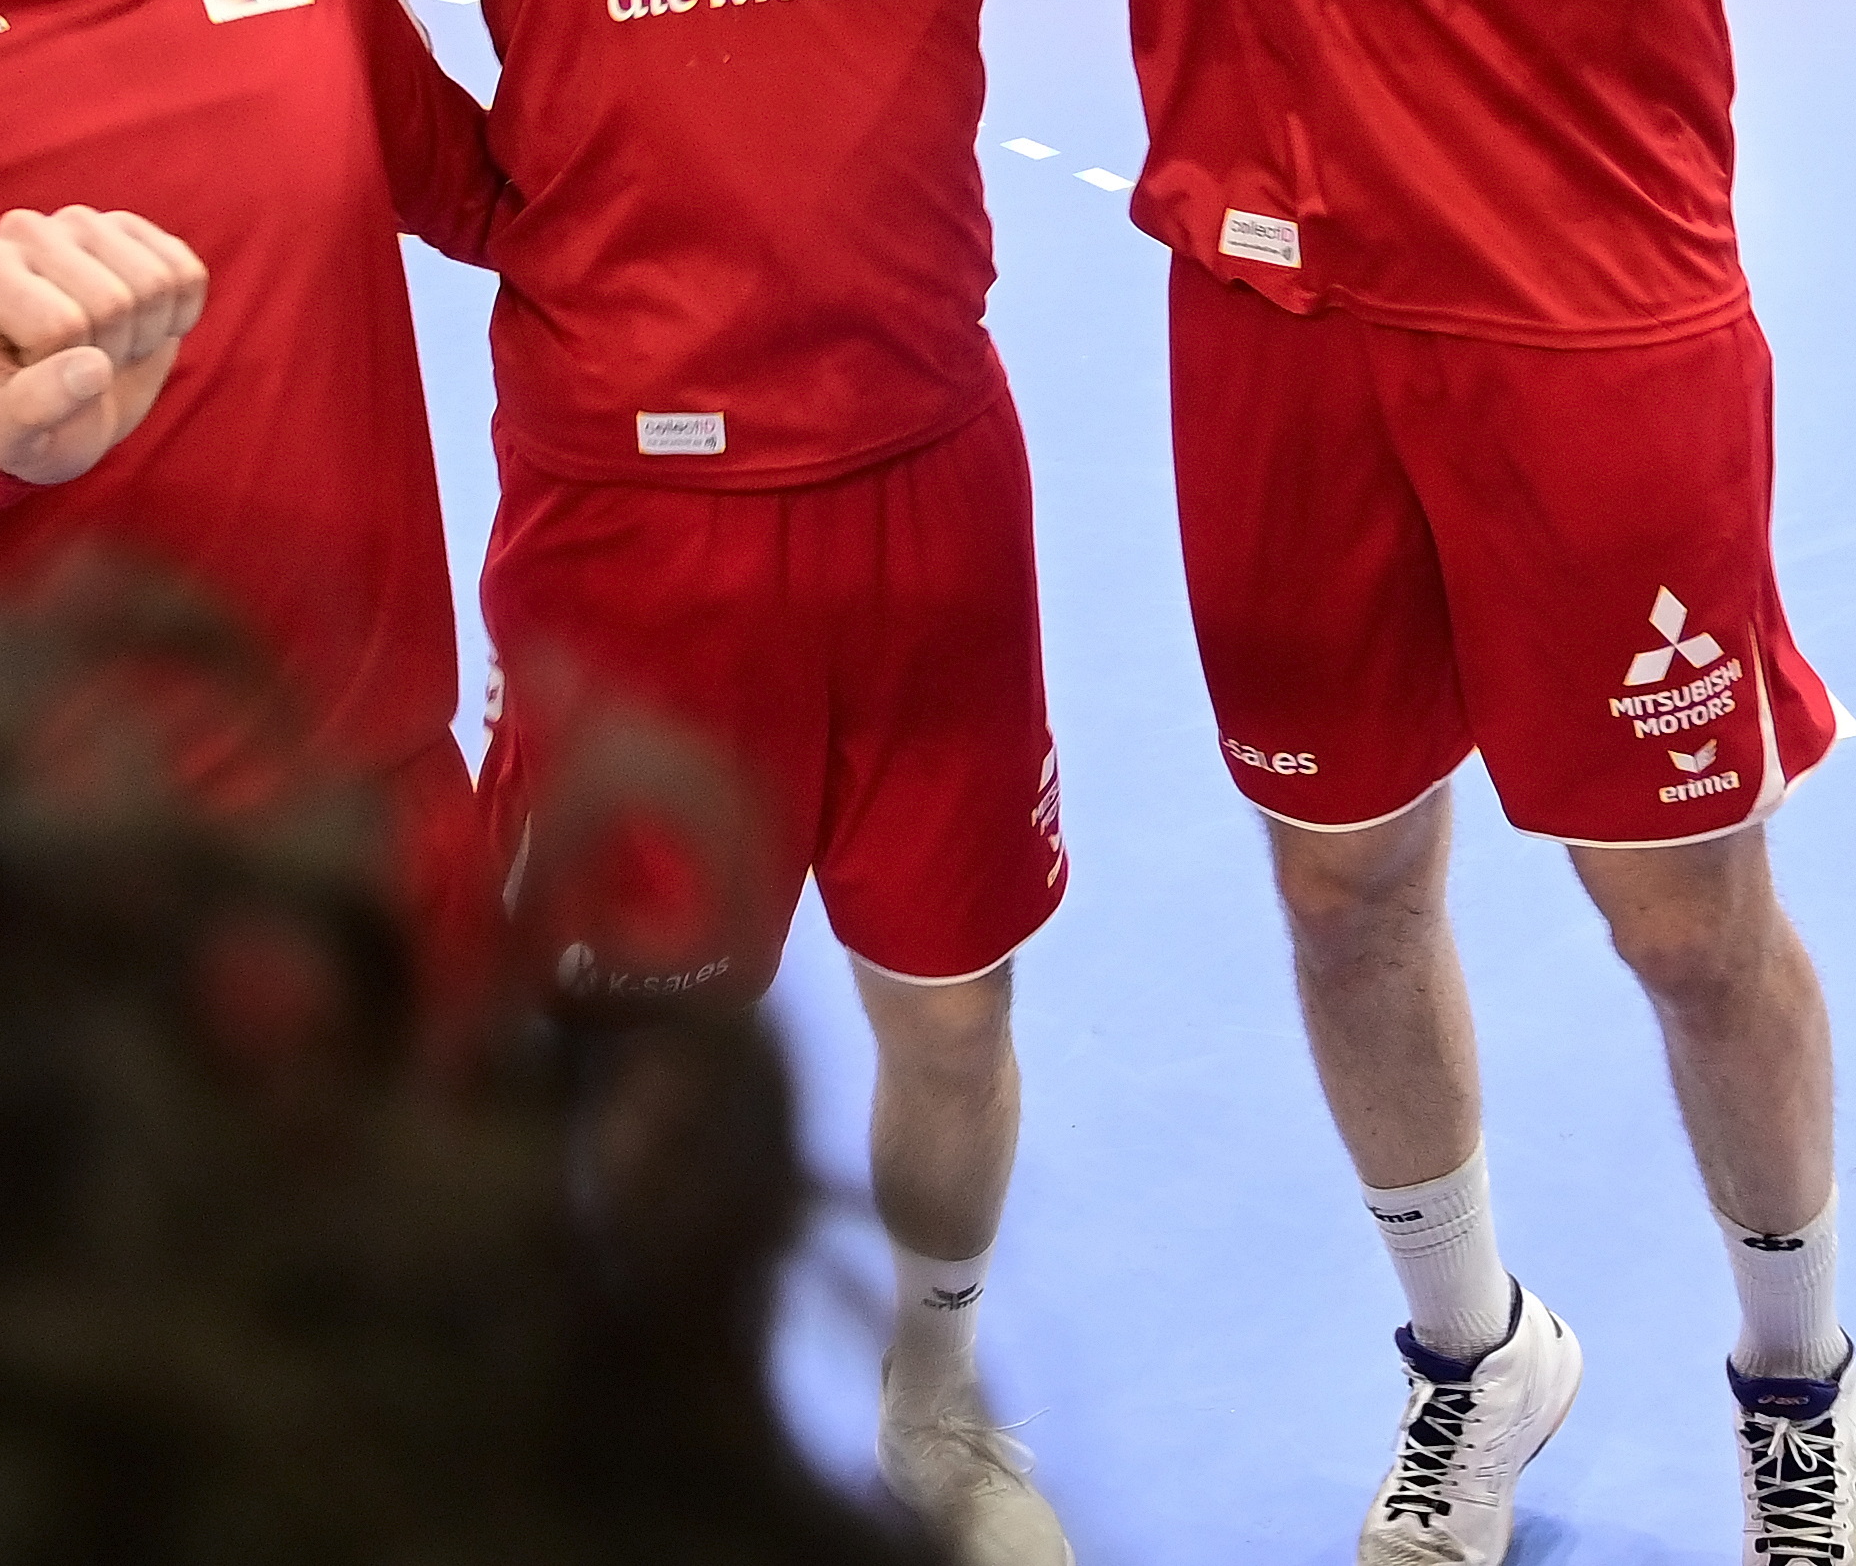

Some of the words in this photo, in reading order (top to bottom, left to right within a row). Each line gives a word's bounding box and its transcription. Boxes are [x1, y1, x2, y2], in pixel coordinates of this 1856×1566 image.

[1608, 657, 1744, 718] MITSUBISHI
[1632, 689, 1737, 739] MOTORS
[1658, 770, 1741, 804] erima
